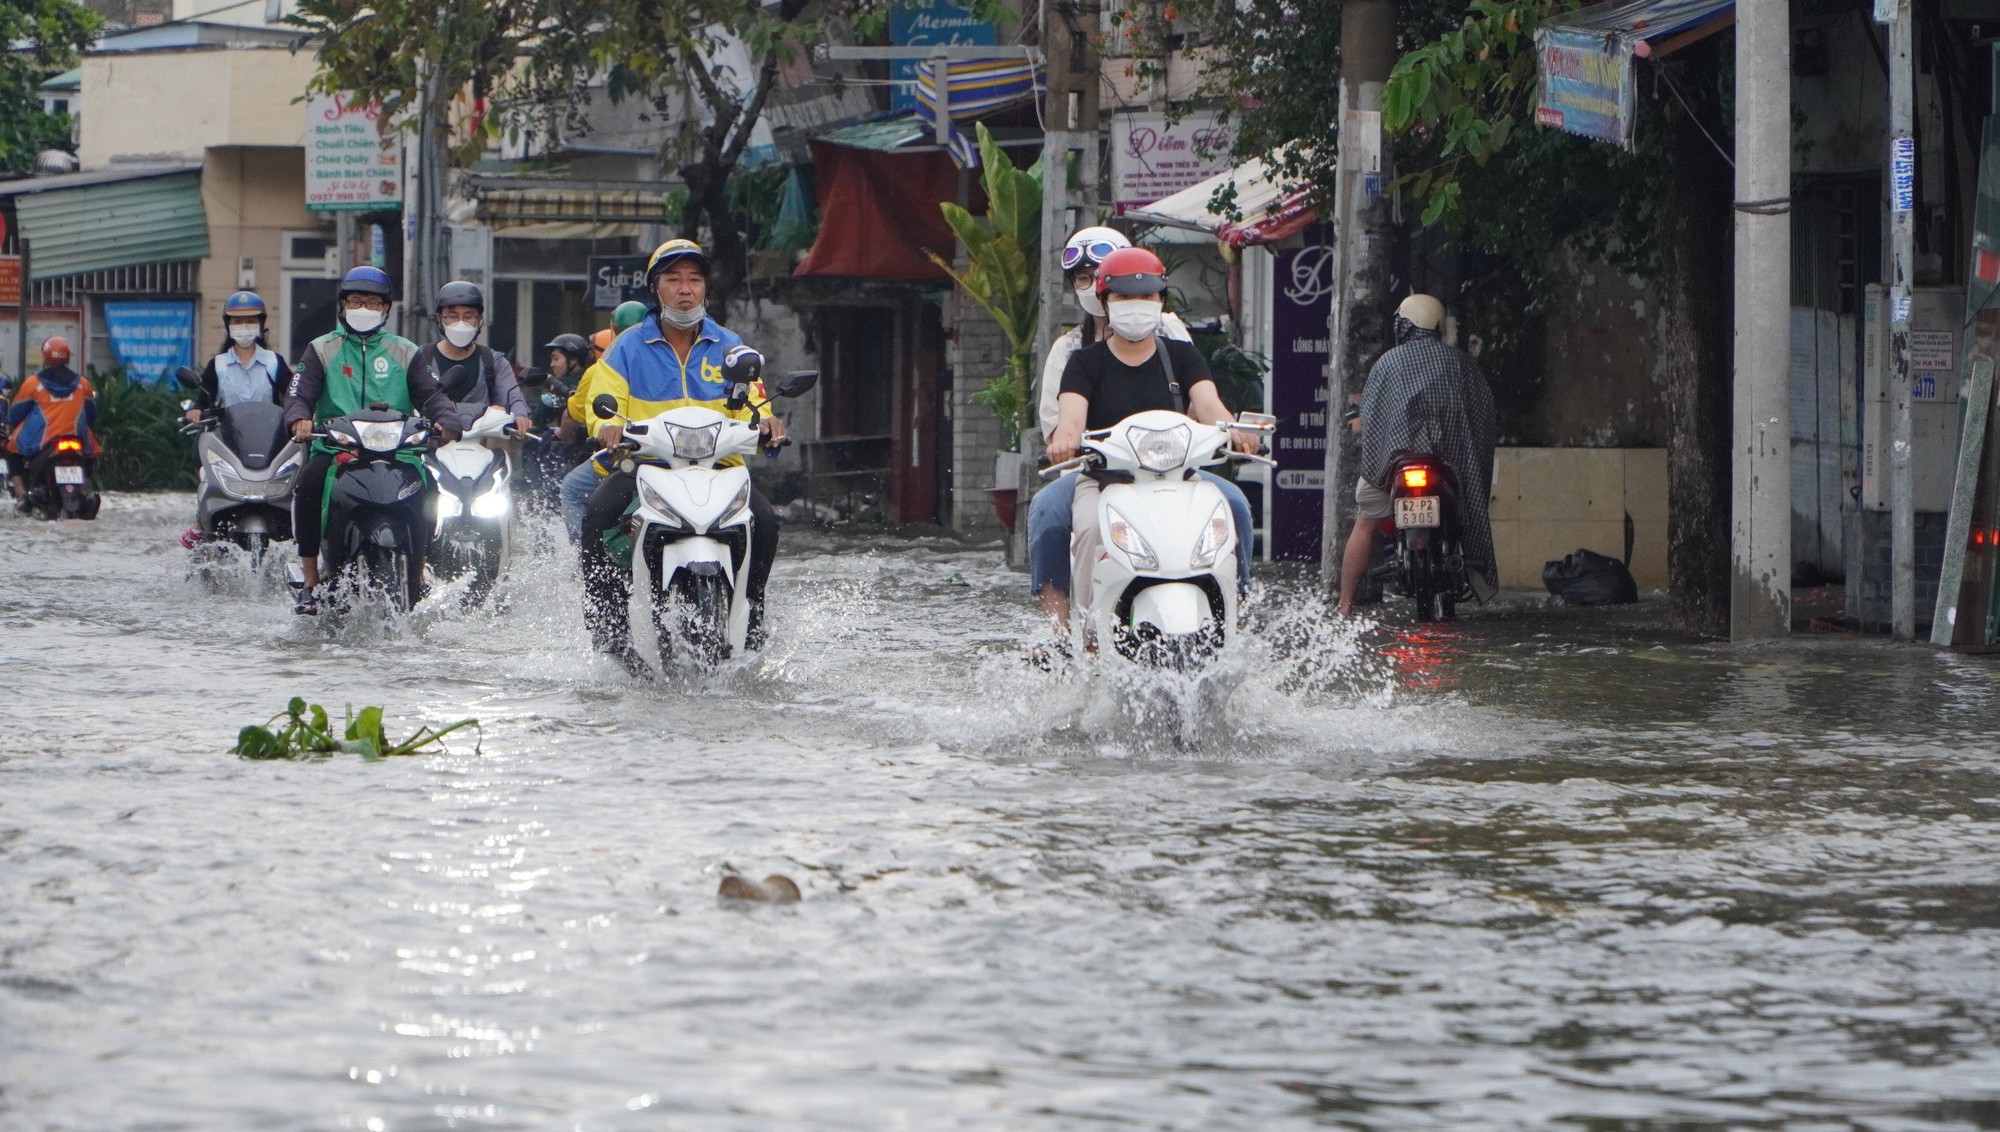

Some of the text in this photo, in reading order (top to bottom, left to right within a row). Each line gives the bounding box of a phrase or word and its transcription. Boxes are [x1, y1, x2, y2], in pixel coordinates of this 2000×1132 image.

[701, 356, 725, 383] be
[1293, 437, 1312, 449] 0918
[1402, 512, 1433, 524] 6305
